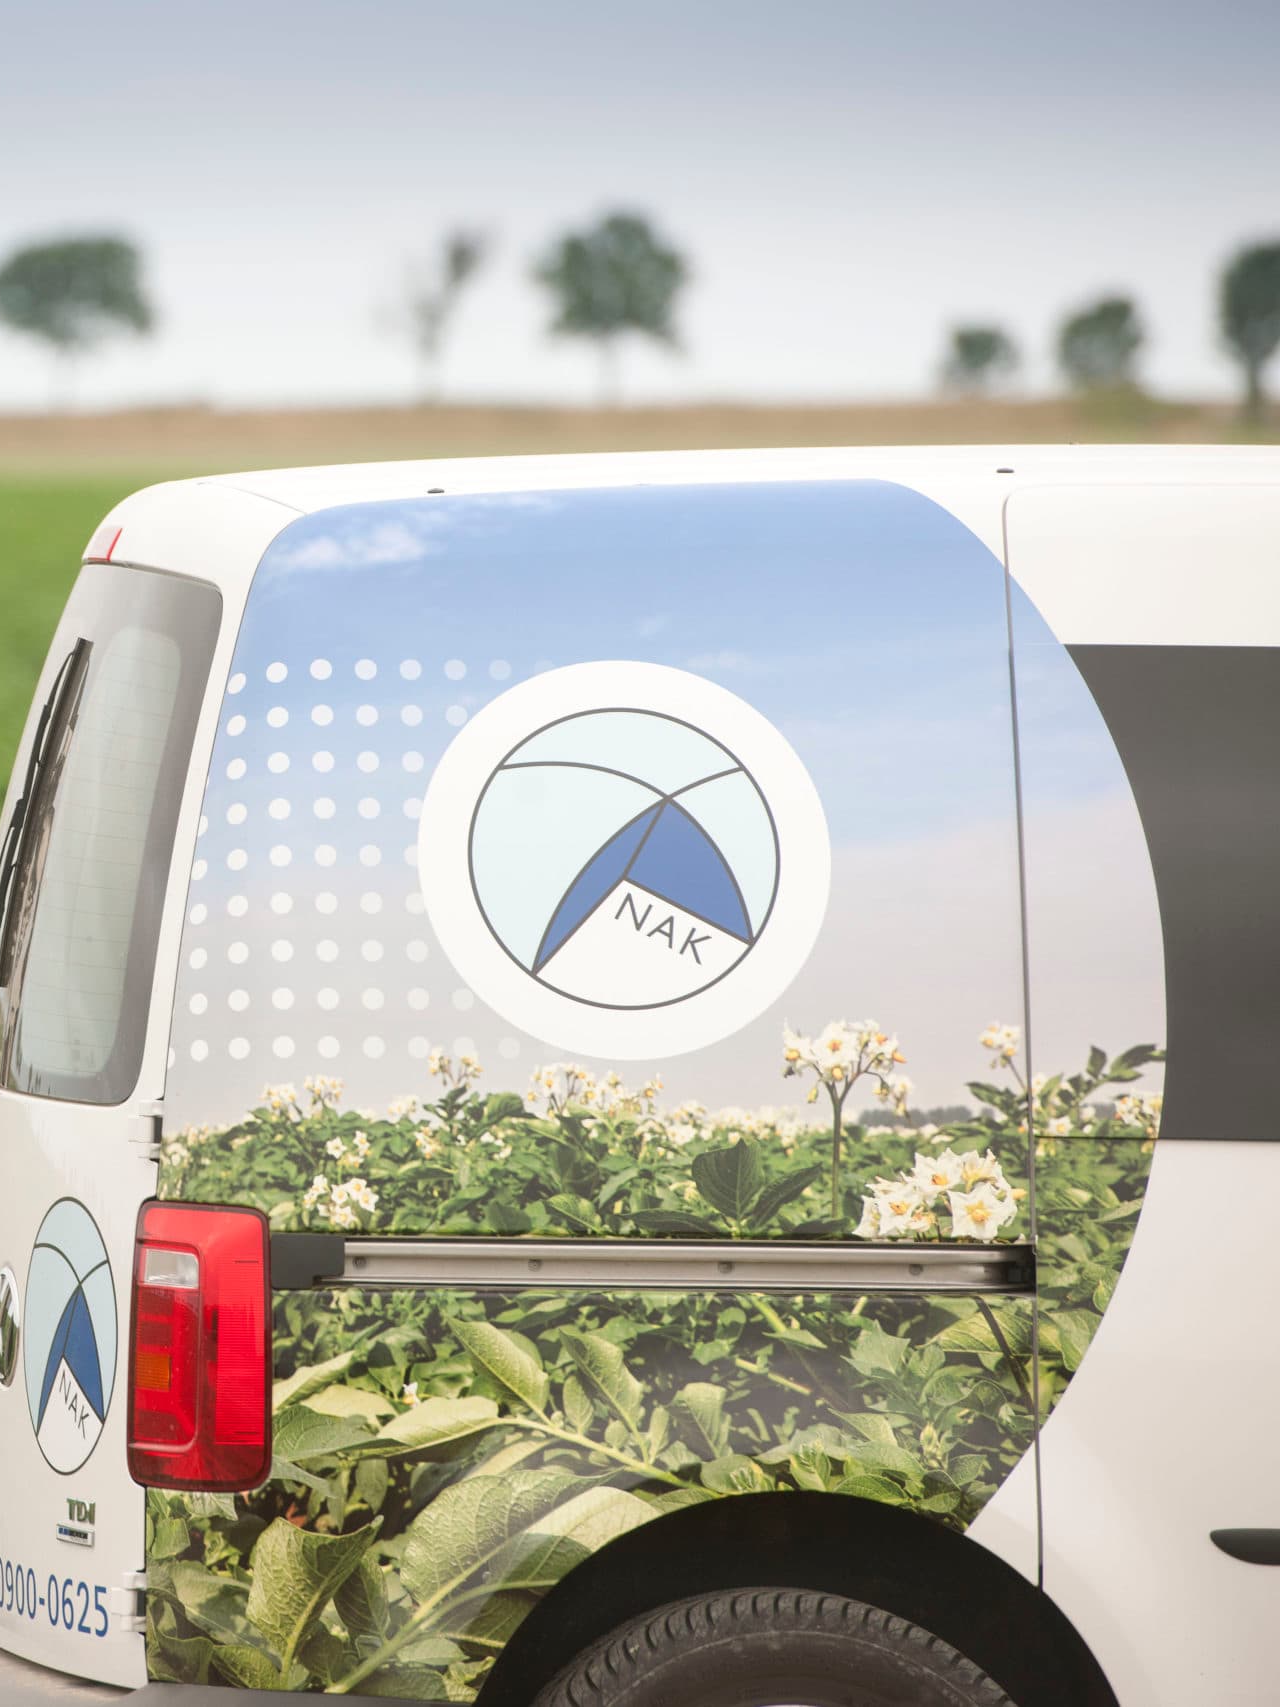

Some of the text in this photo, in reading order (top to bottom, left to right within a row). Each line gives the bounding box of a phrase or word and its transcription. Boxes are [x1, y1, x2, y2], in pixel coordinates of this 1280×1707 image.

[615, 892, 712, 965] NAK
[59, 1370, 89, 1440] NAK
[66, 1498, 96, 1525] TDI
